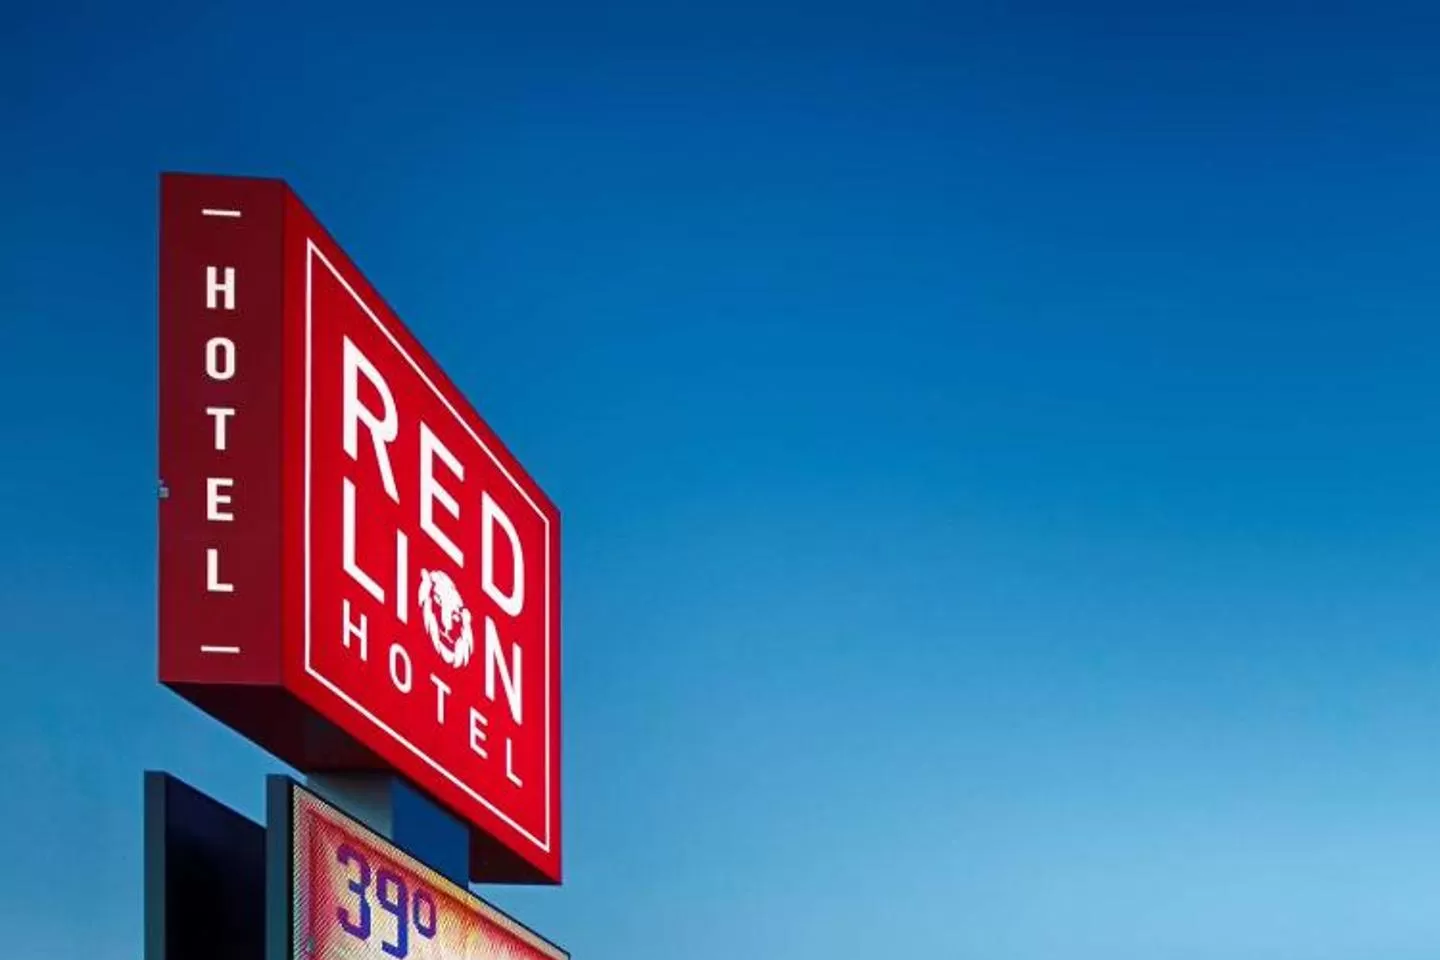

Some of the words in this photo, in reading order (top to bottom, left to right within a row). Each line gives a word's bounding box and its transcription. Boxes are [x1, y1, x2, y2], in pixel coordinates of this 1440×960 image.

[206, 265, 236, 593] HOTEL
[342, 333, 525, 619] RED
[341, 598, 523, 789] HOTEL
